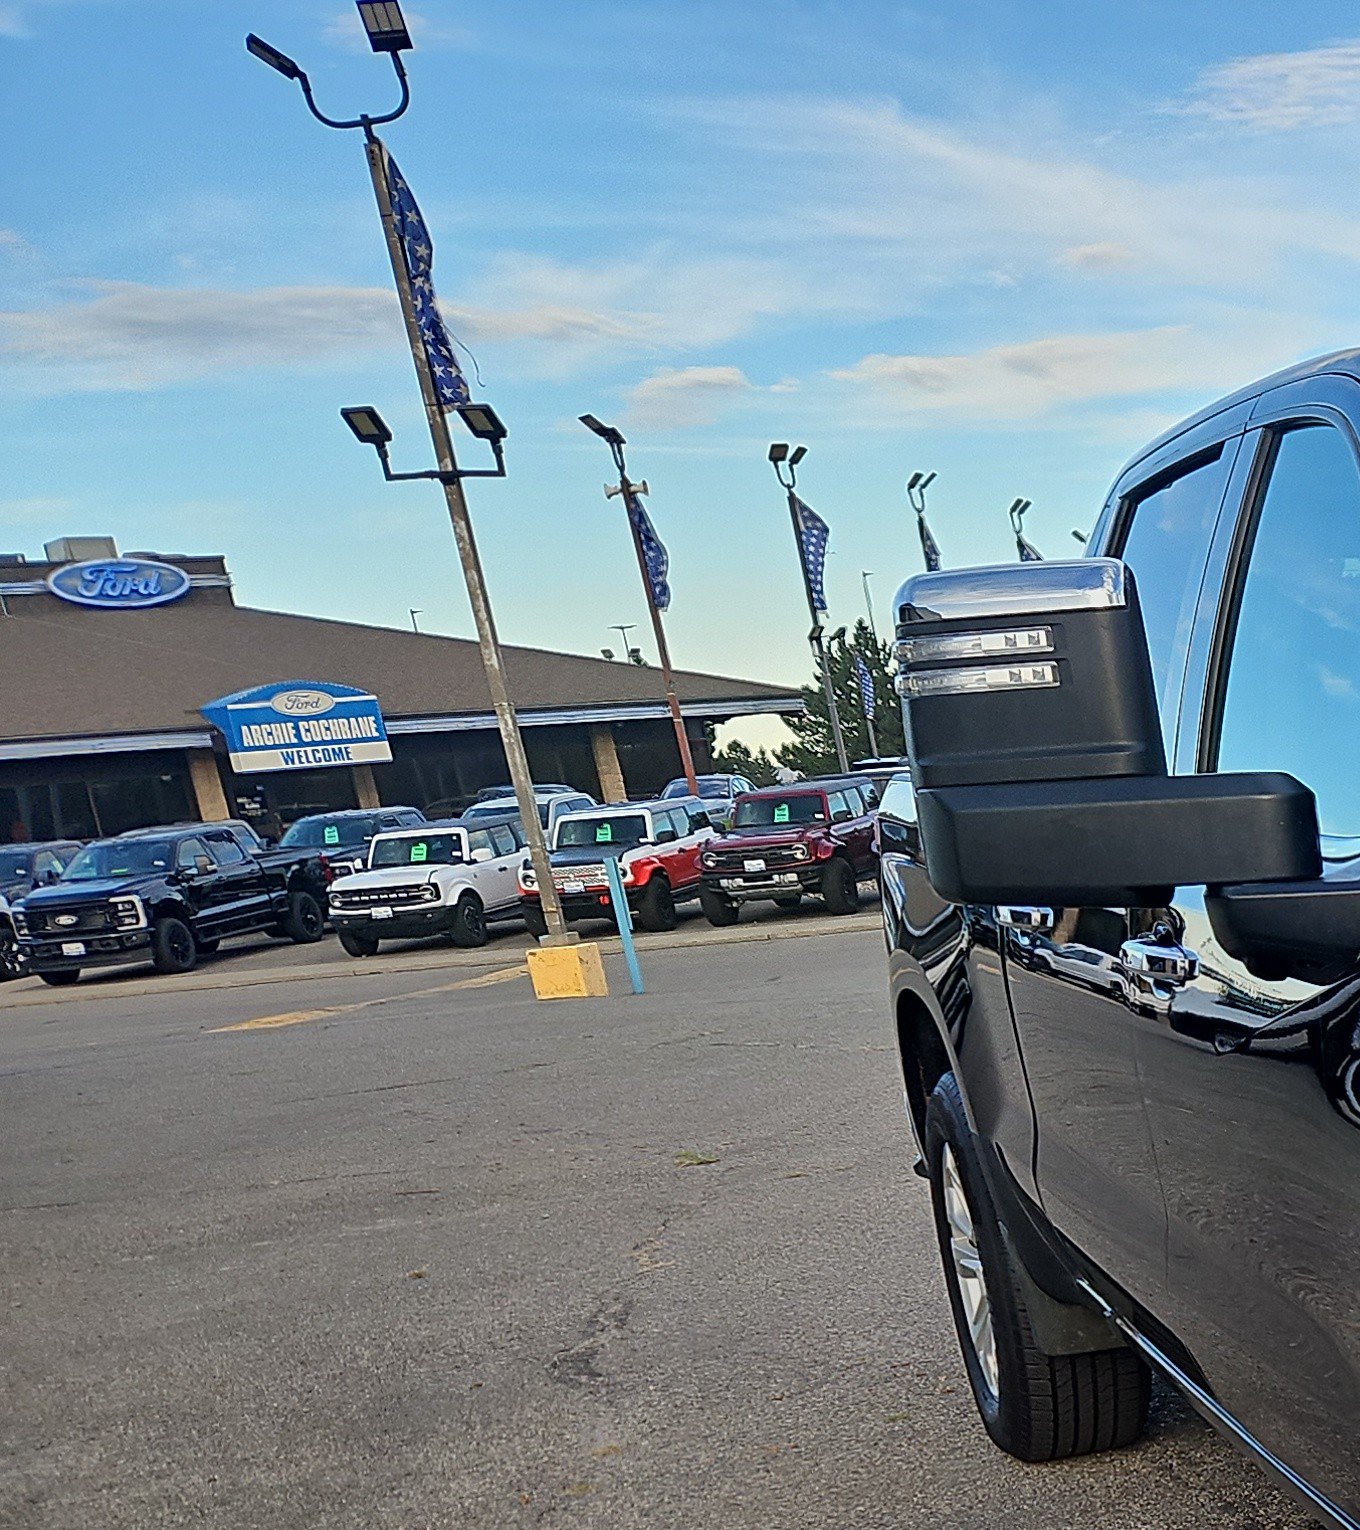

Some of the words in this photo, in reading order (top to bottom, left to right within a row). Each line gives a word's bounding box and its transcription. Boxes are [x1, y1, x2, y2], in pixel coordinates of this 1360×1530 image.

[77, 564, 162, 597] Ford
[284, 694, 322, 711] Ford
[241, 722, 299, 747] ARCHIE
[299, 715, 379, 743] COCHRANE
[280, 746, 353, 766] WELCOME
